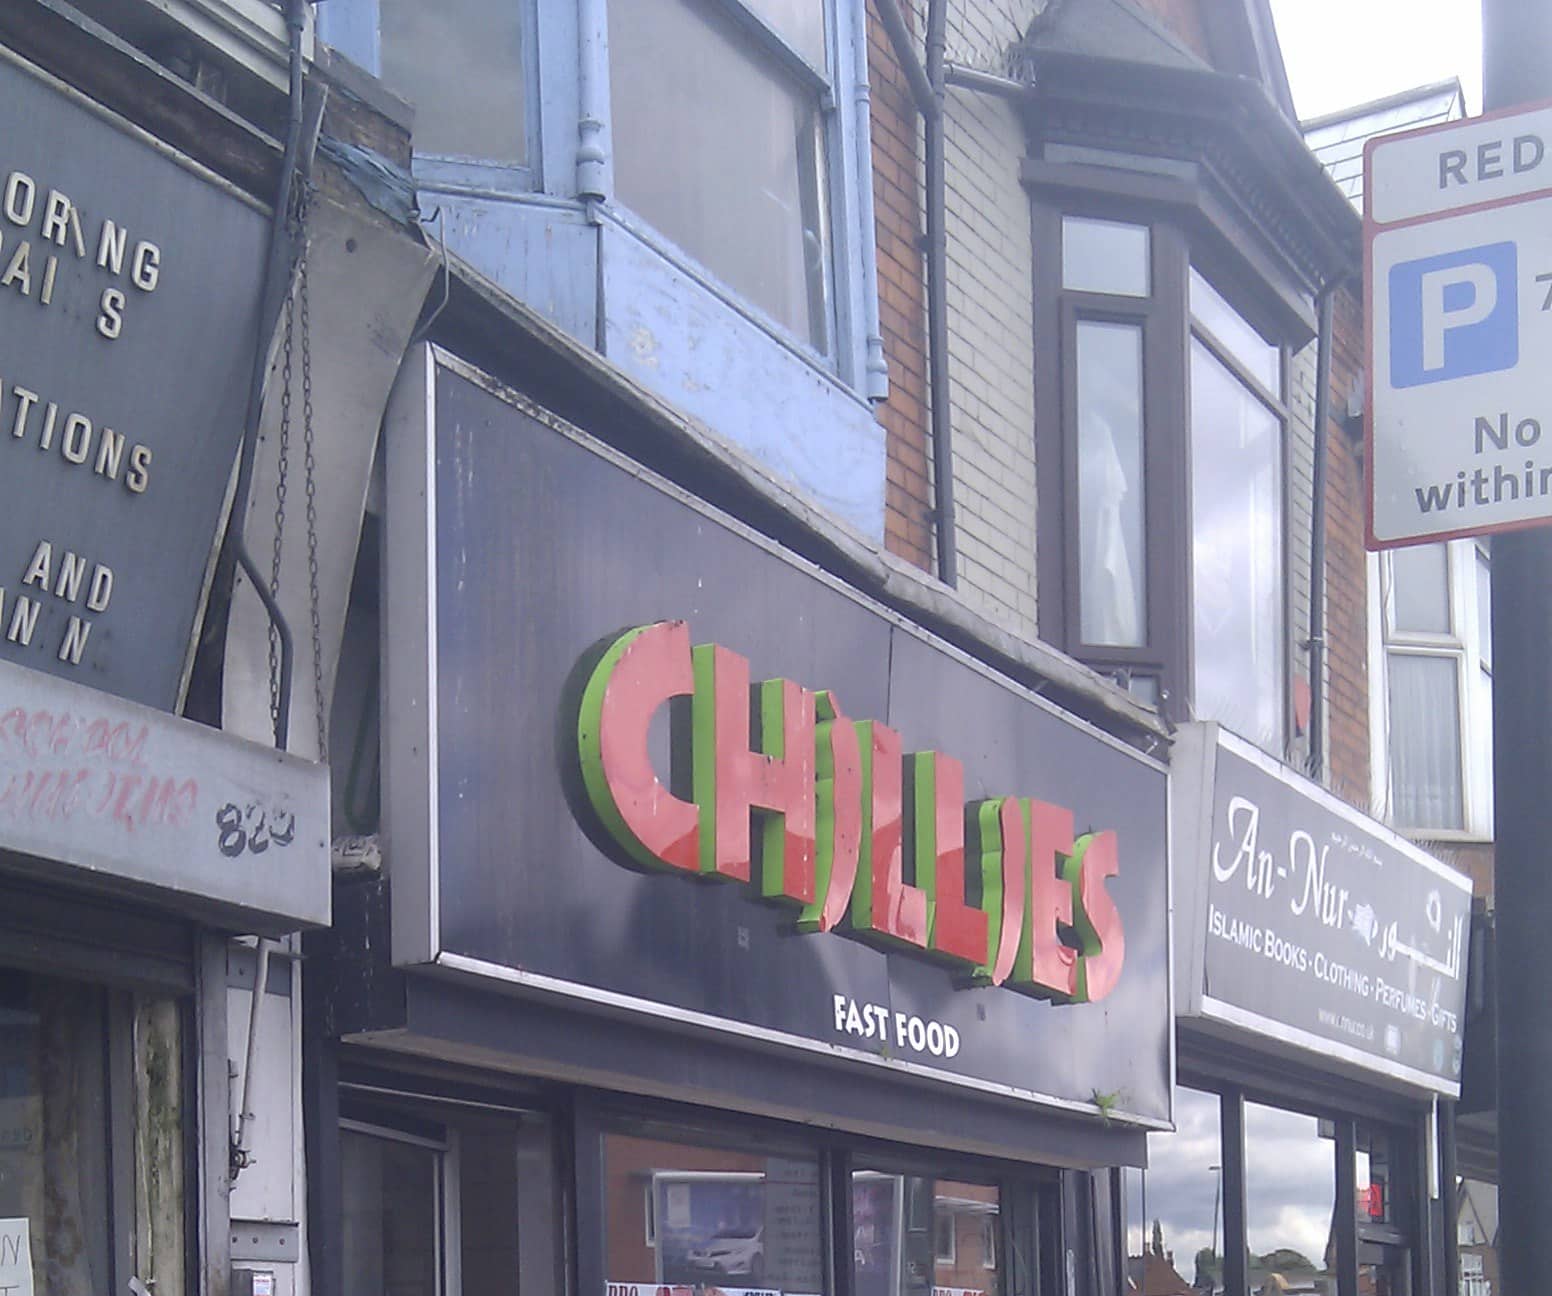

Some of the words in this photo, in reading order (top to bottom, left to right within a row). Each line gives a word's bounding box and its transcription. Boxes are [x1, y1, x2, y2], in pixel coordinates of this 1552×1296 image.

[1439, 133, 1544, 189] RED
[1421, 262, 1498, 372] P
[0, 378, 153, 493] TIONS
[1474, 412, 1541, 455] No
[22, 540, 114, 612] AND
[577, 617, 1128, 1006] CHILLIES
[1208, 903, 1262, 952] ISLAMIC
[1264, 929, 1307, 971] BOOKS
[1314, 952, 1370, 997] CLOTHING
[1375, 977, 1427, 1021] PERFUMES
[1431, 1002, 1458, 1033] GIFTS
[834, 995, 889, 1043] FAST
[895, 1012, 960, 1058] FOOD
